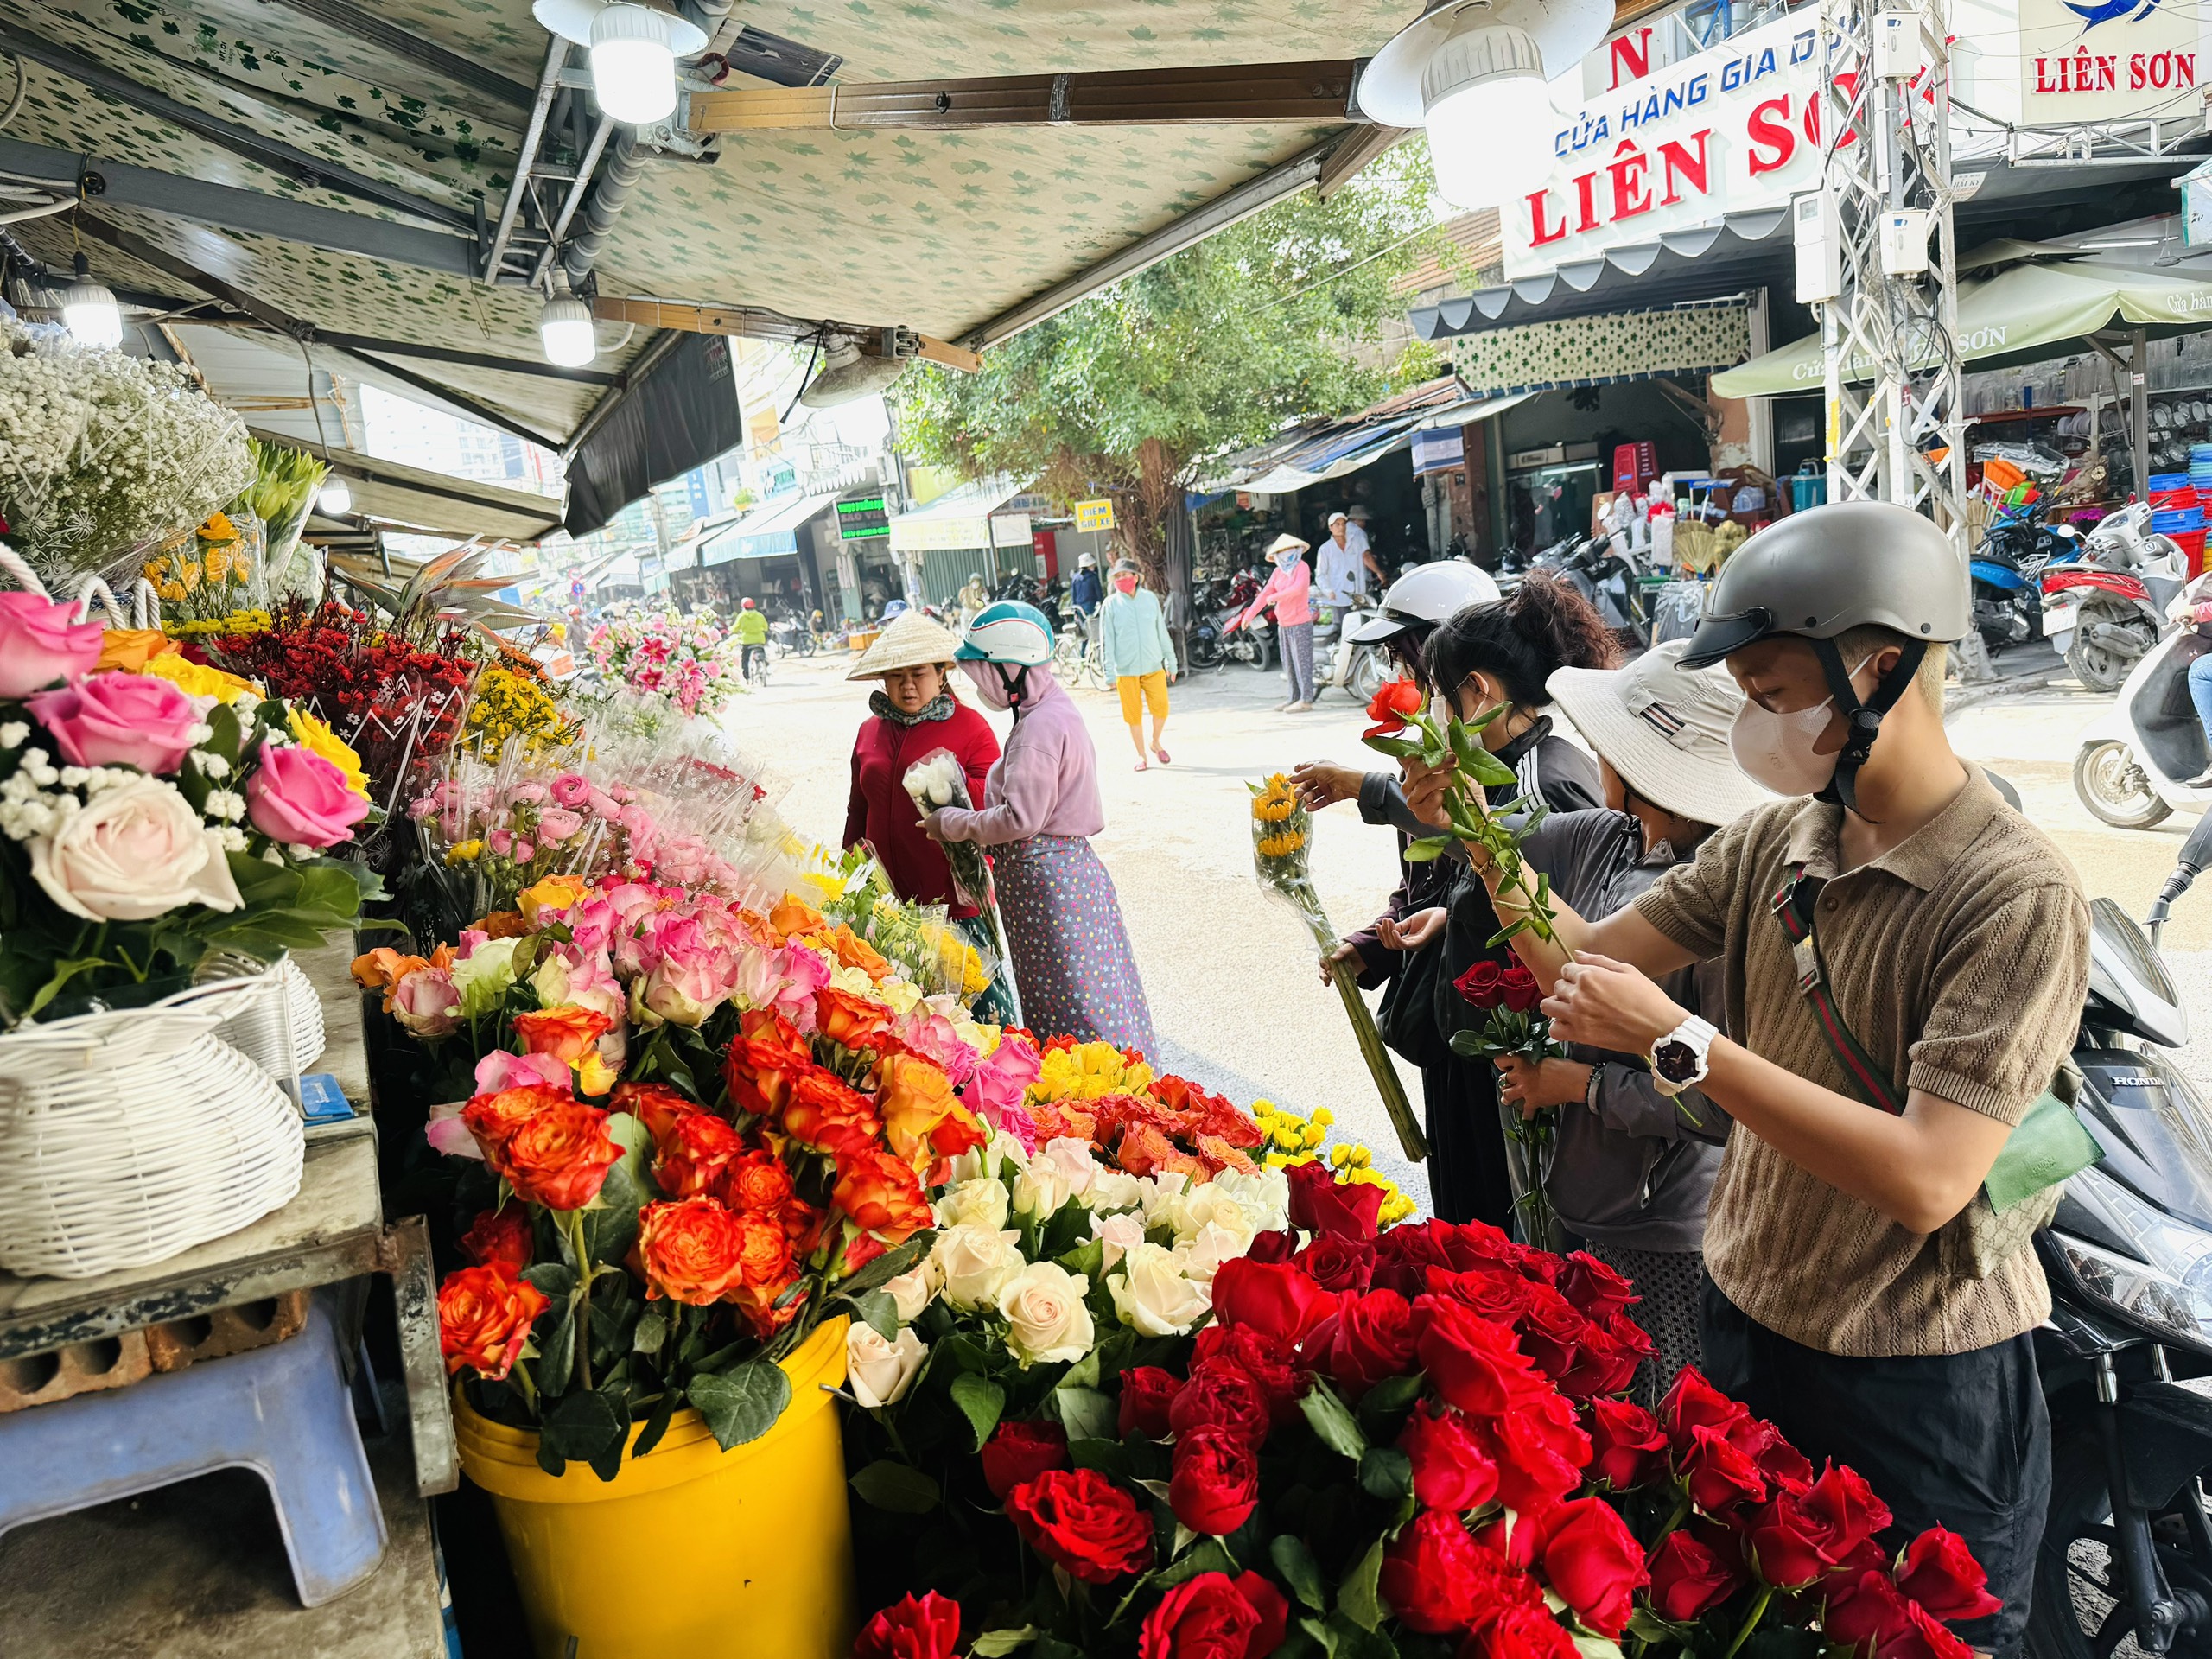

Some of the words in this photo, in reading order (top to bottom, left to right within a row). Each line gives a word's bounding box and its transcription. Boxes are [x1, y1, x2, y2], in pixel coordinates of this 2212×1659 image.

[2035, 45, 2117, 92] LIÊN
[2130, 49, 2196, 90] SƠN
[1554, 111, 1609, 158] CỬA
[1621, 73, 1707, 132] HÀNG
[1720, 47, 1776, 92] GIA
[1525, 128, 1711, 247] LIÊN
[2167, 293, 2187, 314] Cửa
[1957, 326, 2008, 353] SƠN
[2112, 1077, 2166, 1086] HONDA
